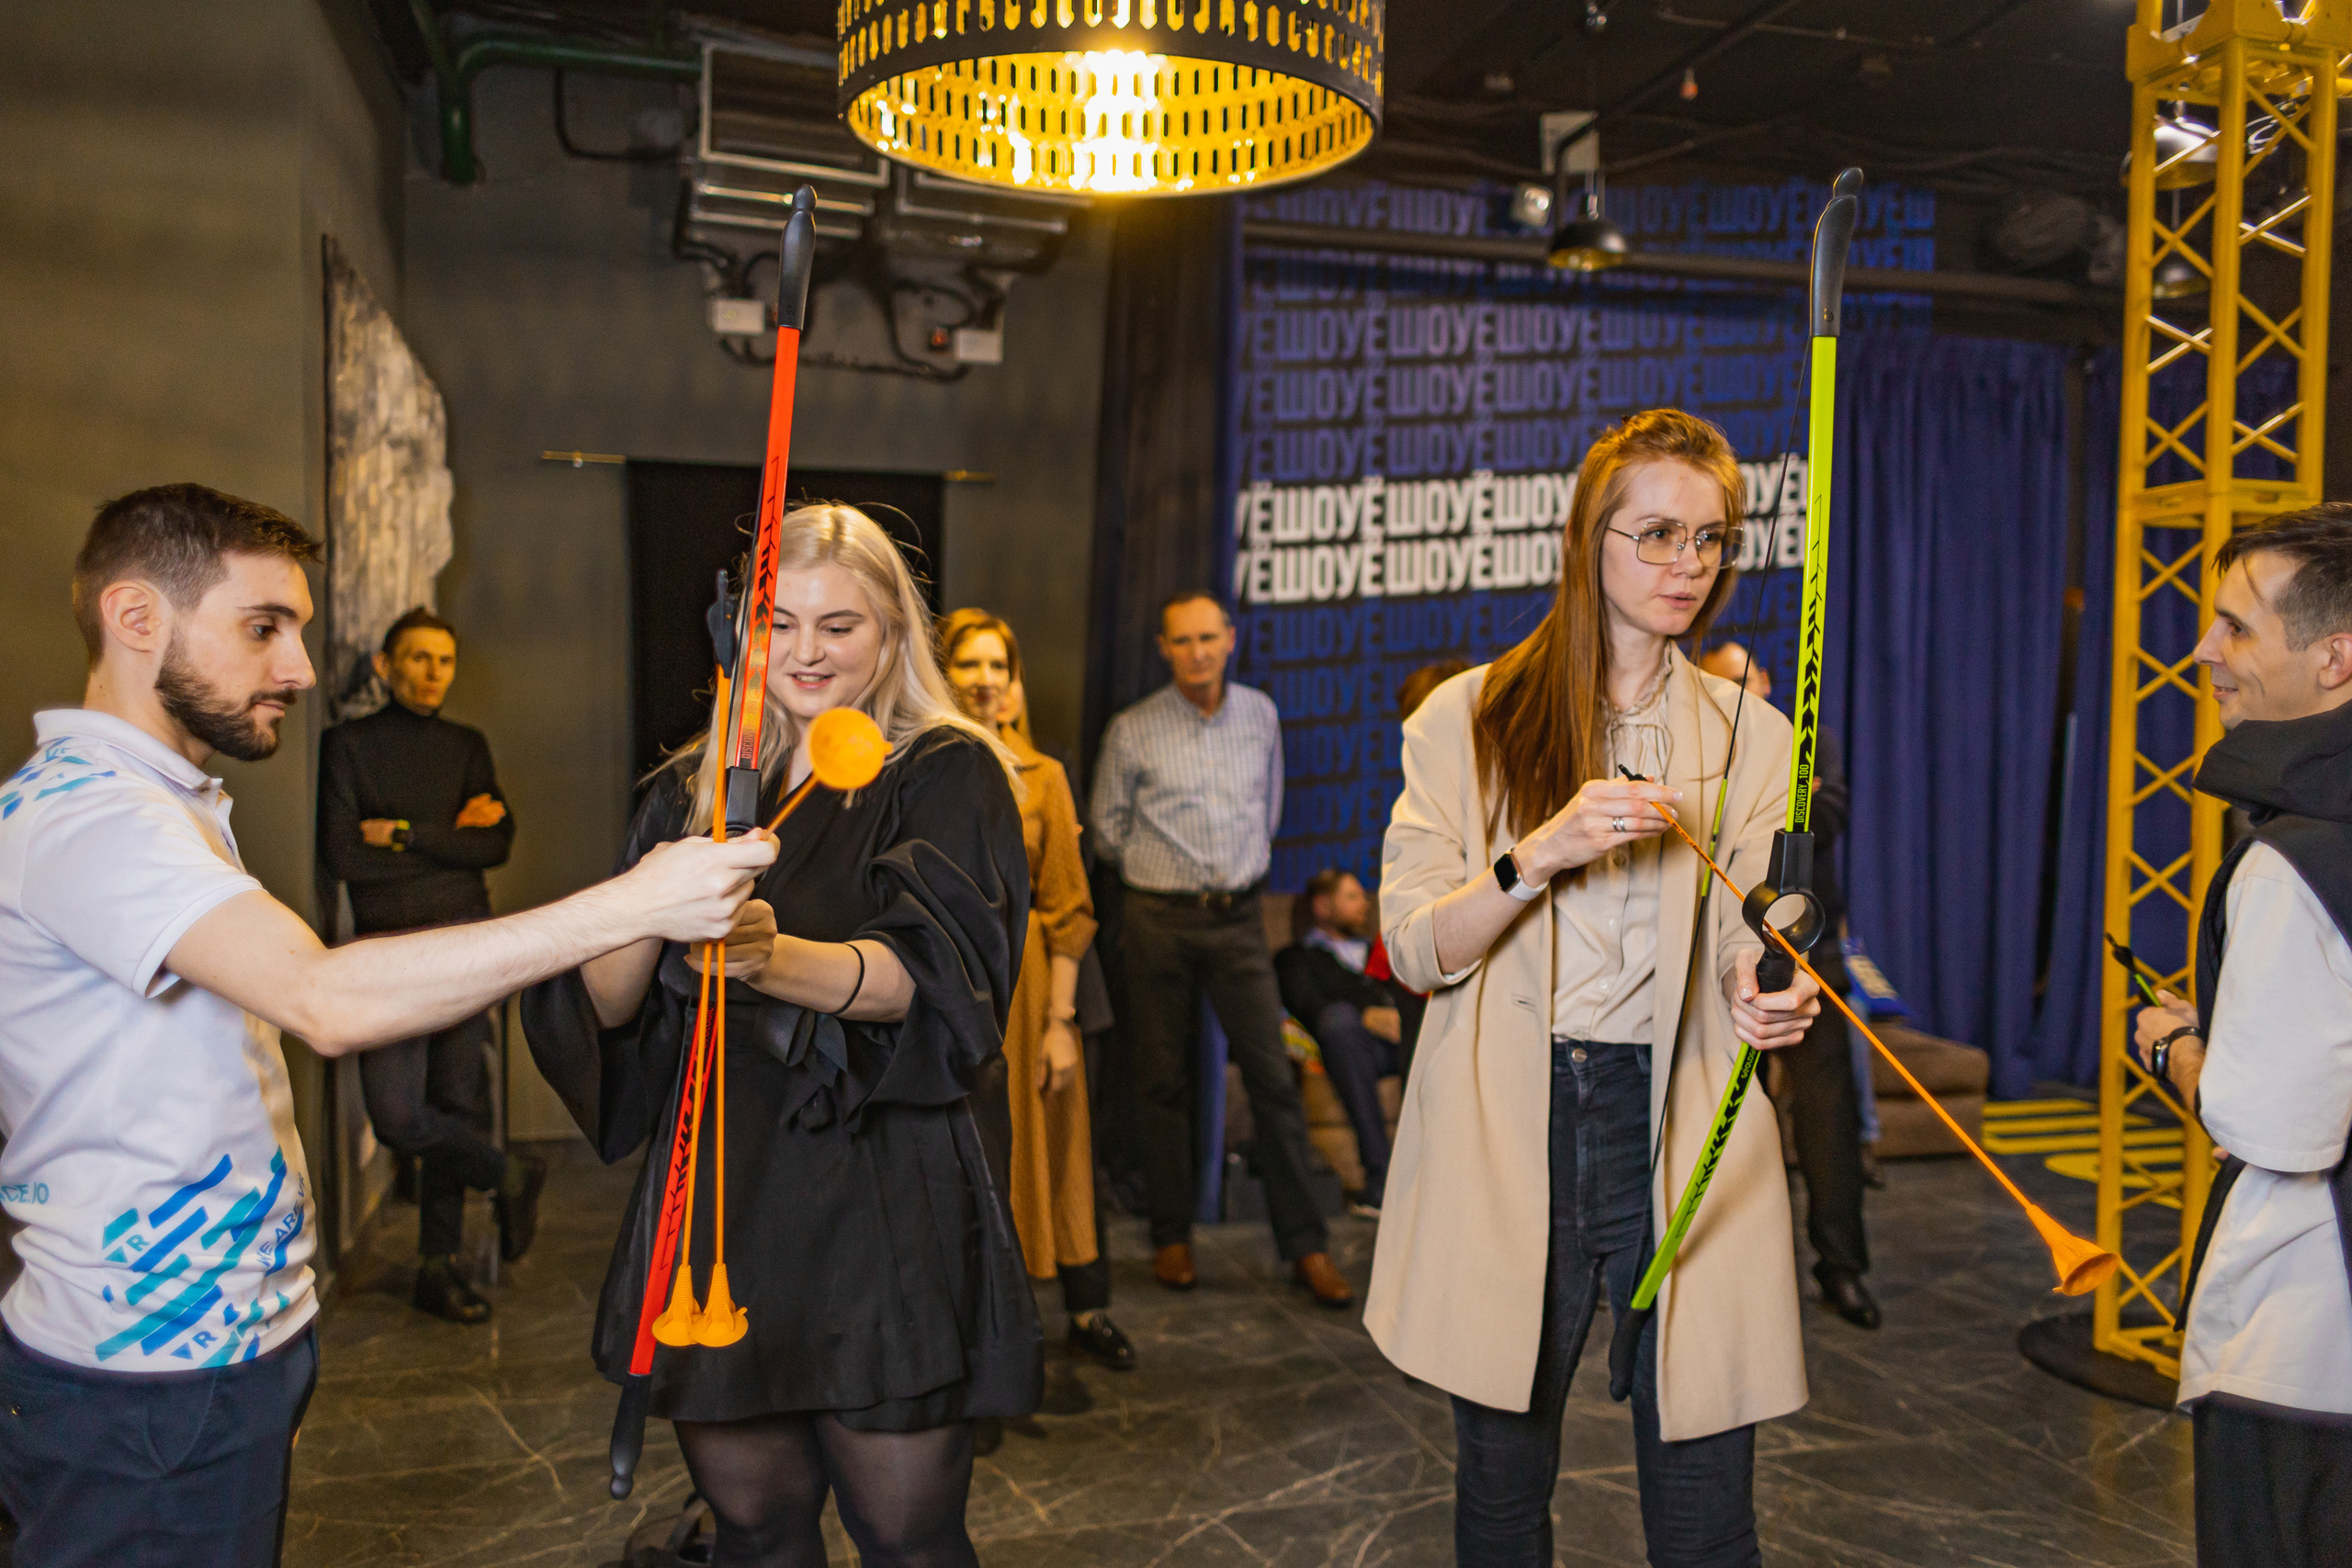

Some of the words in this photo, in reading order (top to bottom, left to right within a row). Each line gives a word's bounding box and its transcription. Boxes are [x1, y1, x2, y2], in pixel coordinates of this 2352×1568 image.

[1798, 764, 1810, 779] 100
[1794, 784, 1808, 823] DISCOVERY
[256, 1240, 274, 1268] WE
[275, 1199, 301, 1244] ARE
